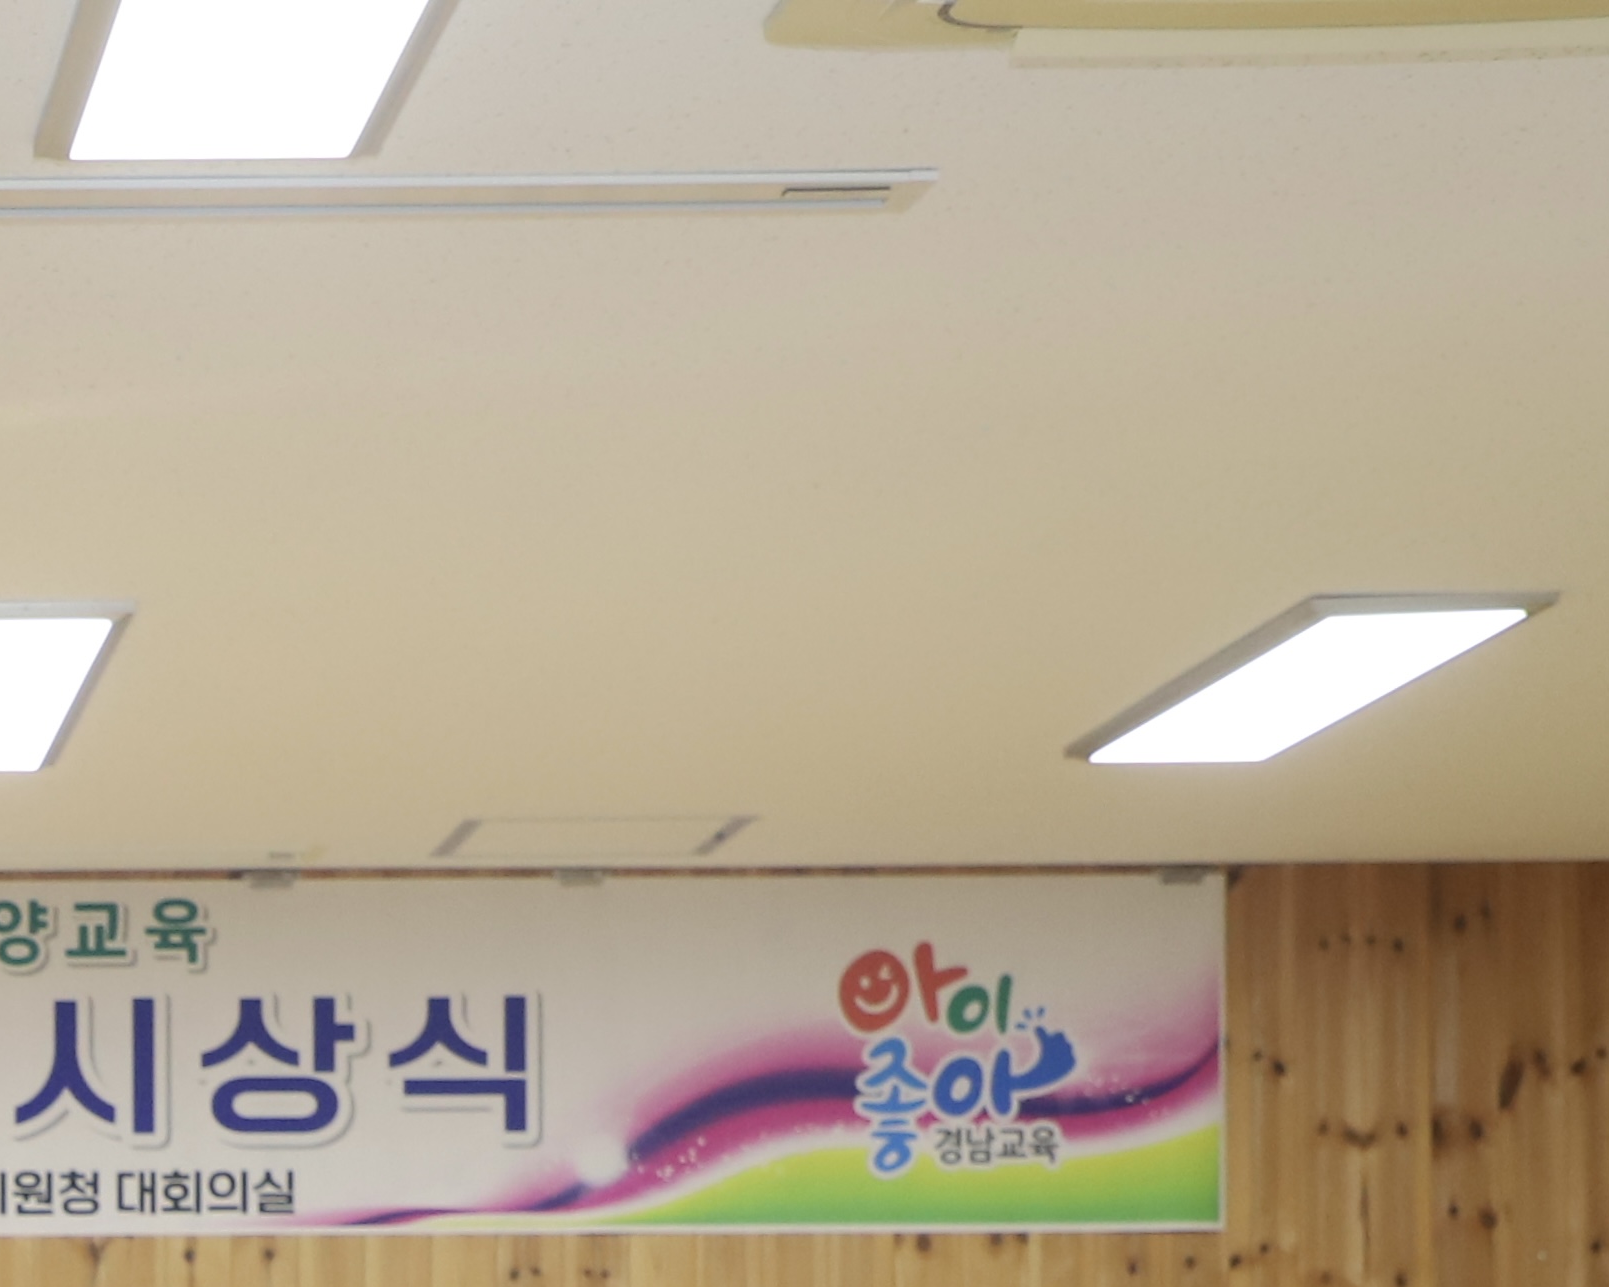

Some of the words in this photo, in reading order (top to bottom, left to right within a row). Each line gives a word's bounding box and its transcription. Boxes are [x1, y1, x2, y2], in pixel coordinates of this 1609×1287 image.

[15, 995, 528, 1135] 시상식
[934, 1126, 1059, 1165] 경남교육
[116, 1170, 295, 1215] 대회의실
